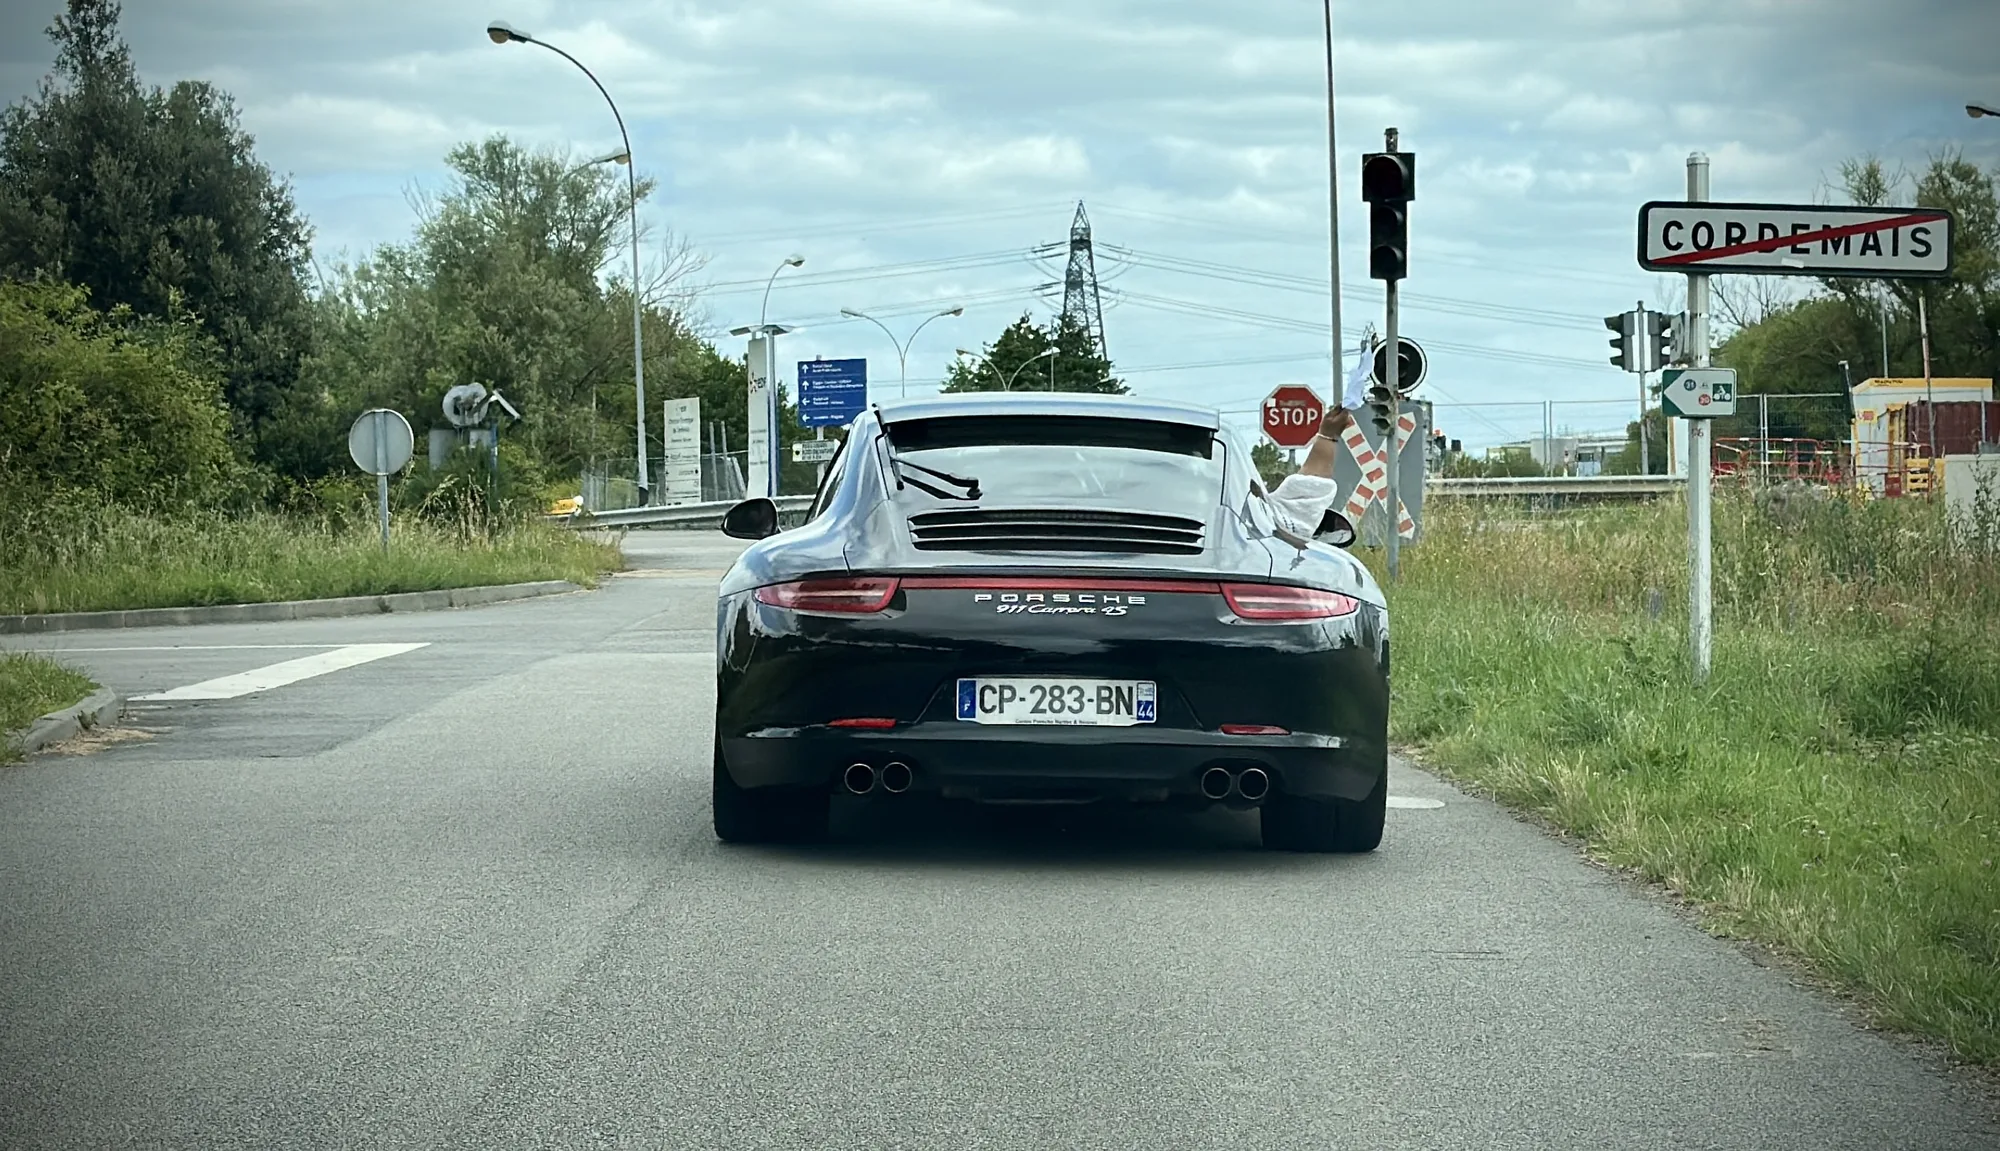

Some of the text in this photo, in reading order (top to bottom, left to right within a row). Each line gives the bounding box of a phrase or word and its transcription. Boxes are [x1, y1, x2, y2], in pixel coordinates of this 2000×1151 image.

[1662, 220, 1933, 258] CORDEMAIS
[1268, 408, 1318, 426] STOP
[974, 594, 1146, 605] PORSCHE
[996, 604, 1129, 616] 911 Carrera 4S
[979, 685, 1134, 716] CP-283-BN
[1137, 704, 1154, 719] 44
